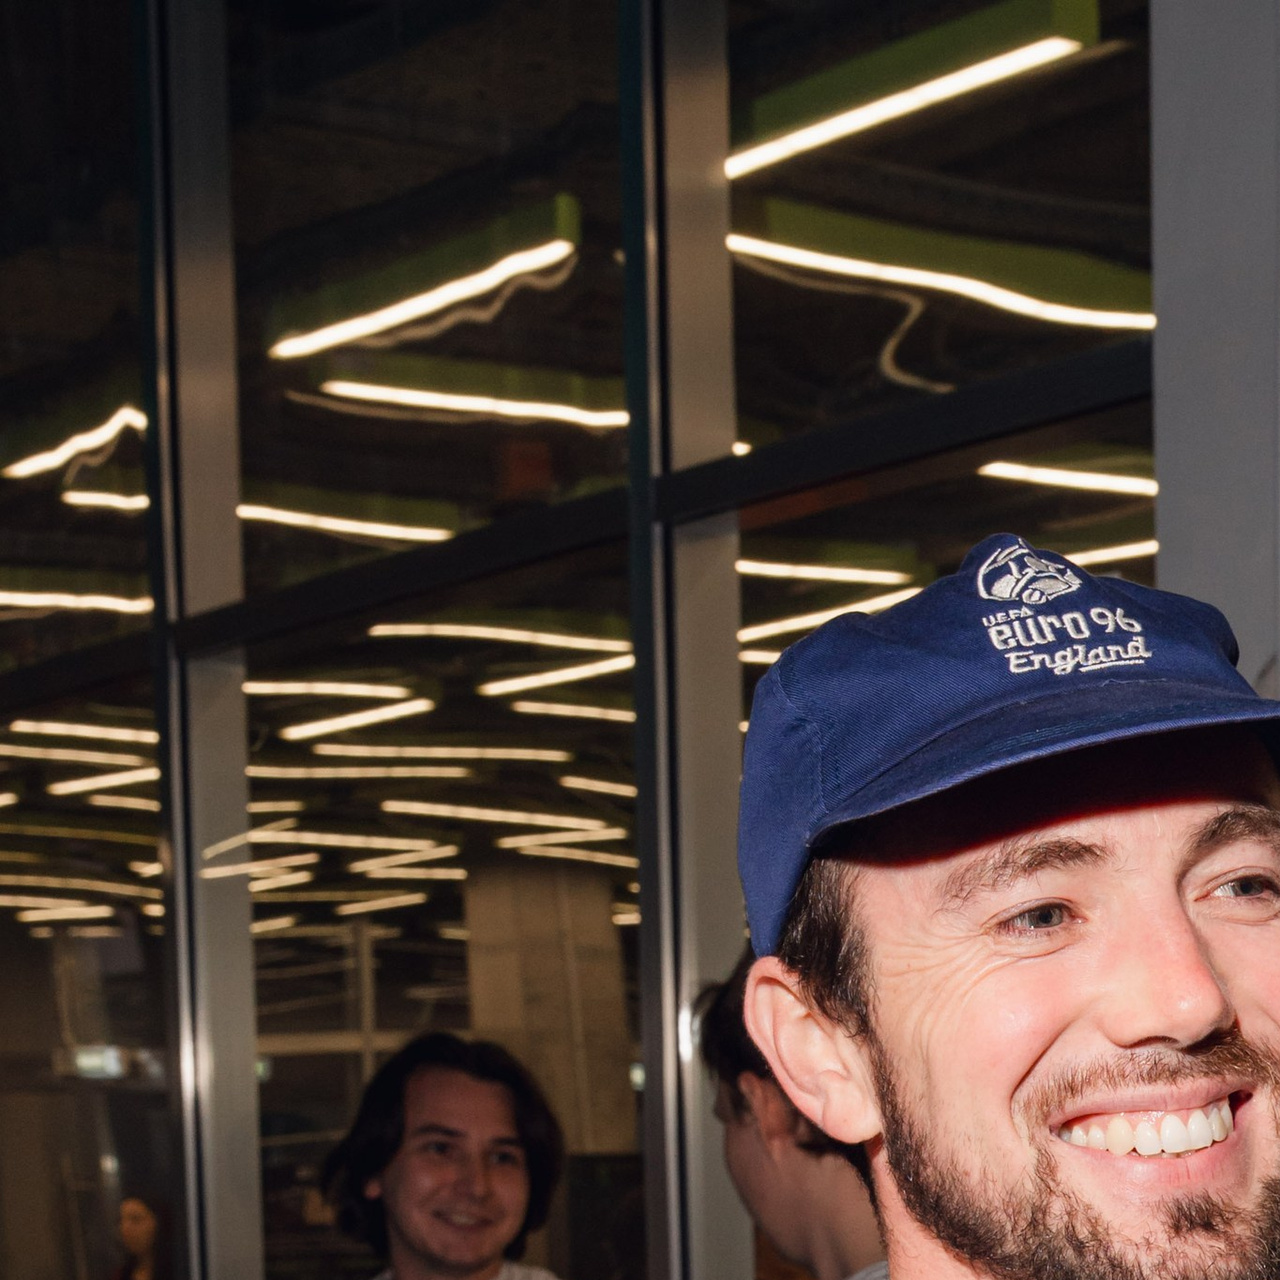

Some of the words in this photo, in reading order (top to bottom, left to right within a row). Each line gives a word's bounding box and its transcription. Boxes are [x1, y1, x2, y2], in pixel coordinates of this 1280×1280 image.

[982, 605, 1034, 627] UEFA
[1090, 606, 1142, 633] 96
[1004, 636, 1152, 676] England
